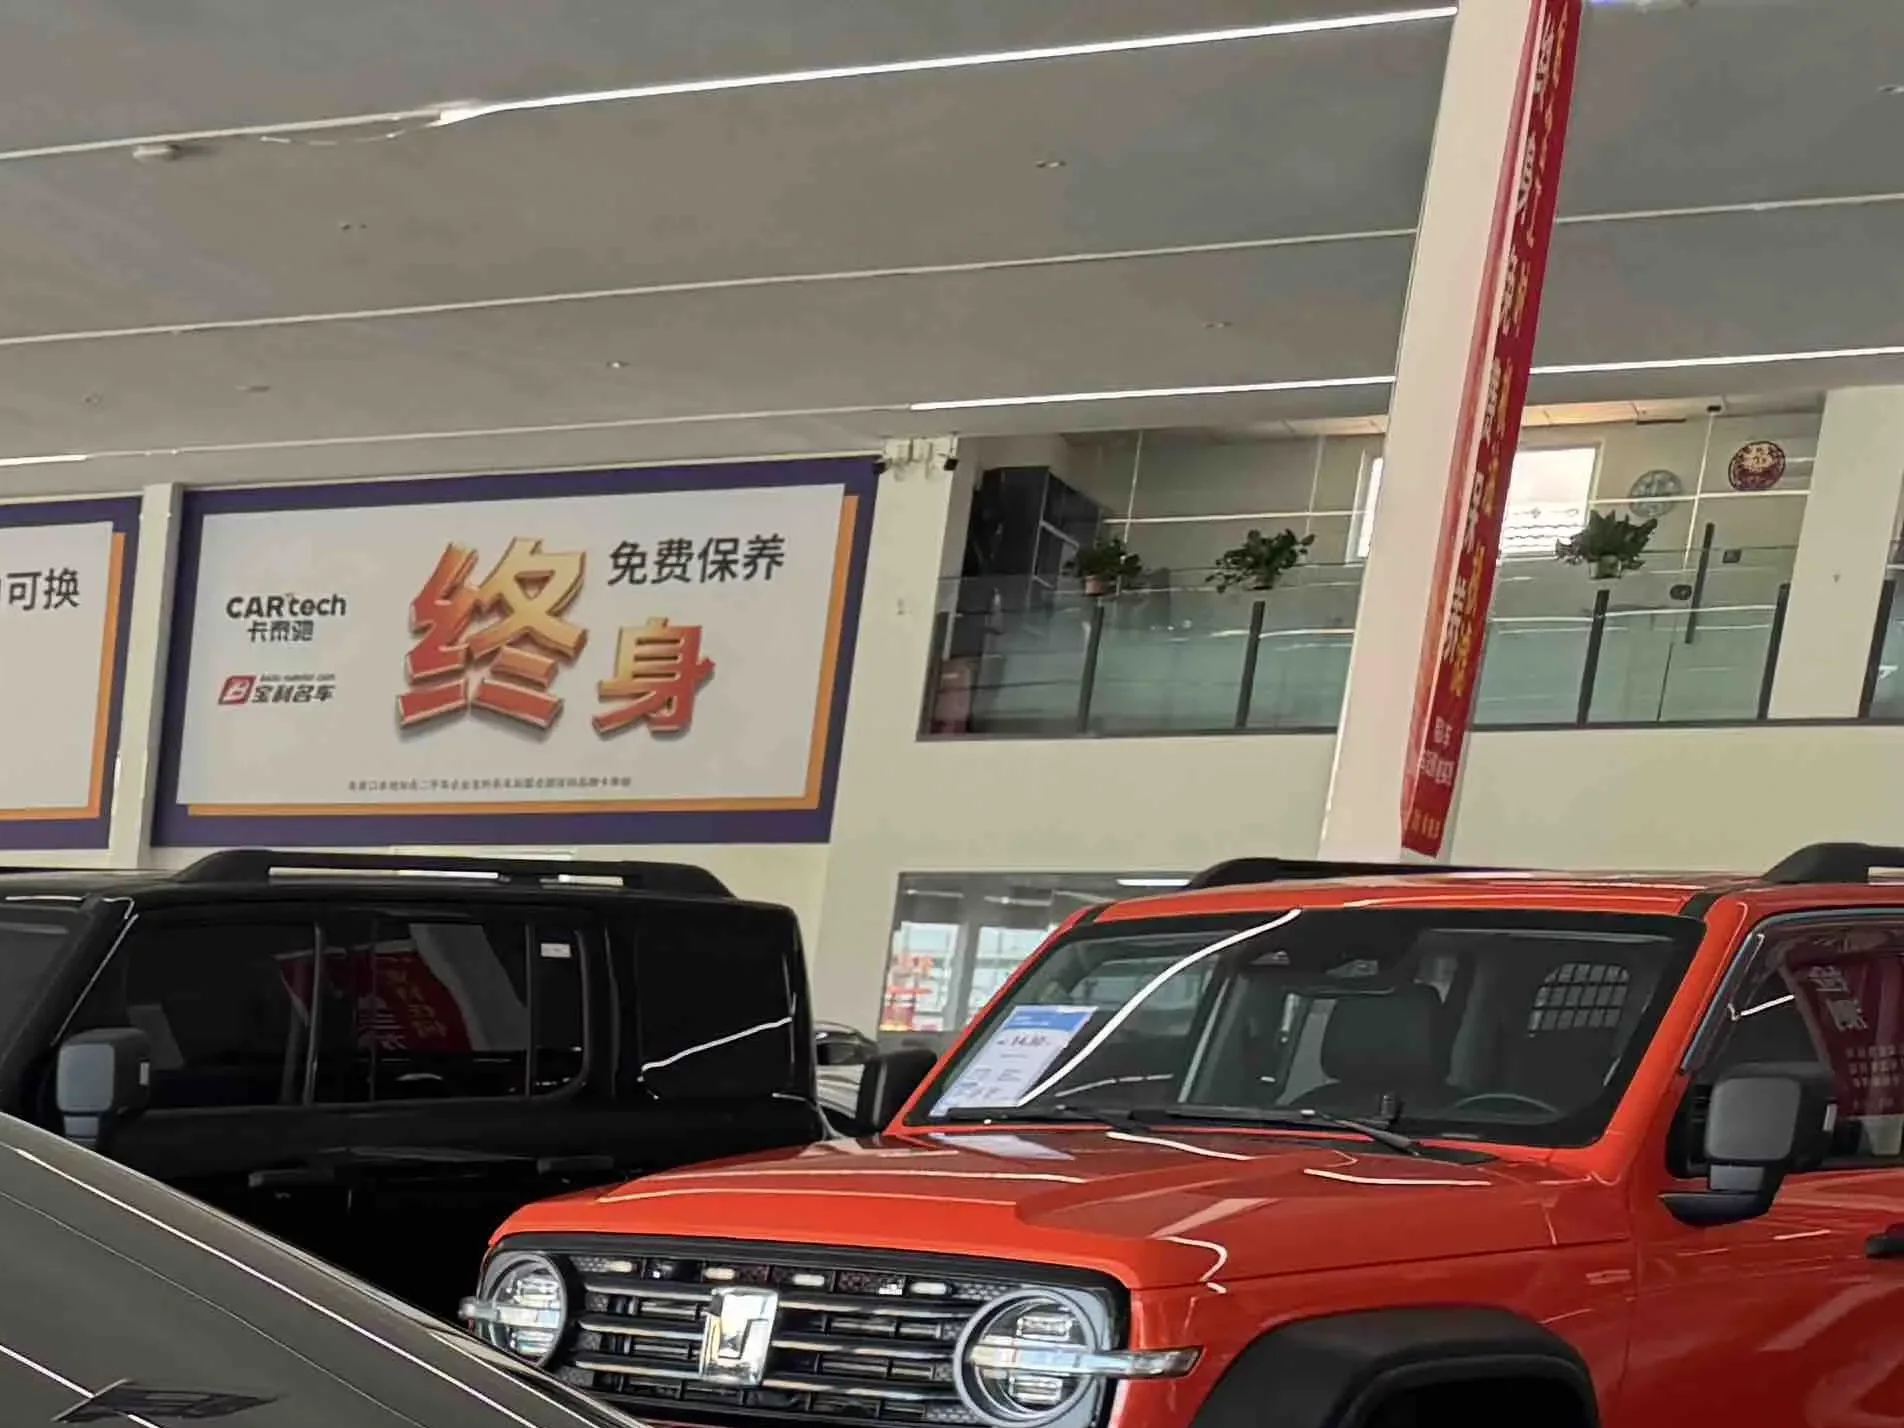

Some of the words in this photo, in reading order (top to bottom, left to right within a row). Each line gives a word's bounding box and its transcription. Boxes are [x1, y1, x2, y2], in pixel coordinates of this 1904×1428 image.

[607, 534, 787, 586] 免费保养
[225, 593, 347, 619] CARtech
[397, 536, 715, 738] 终身
